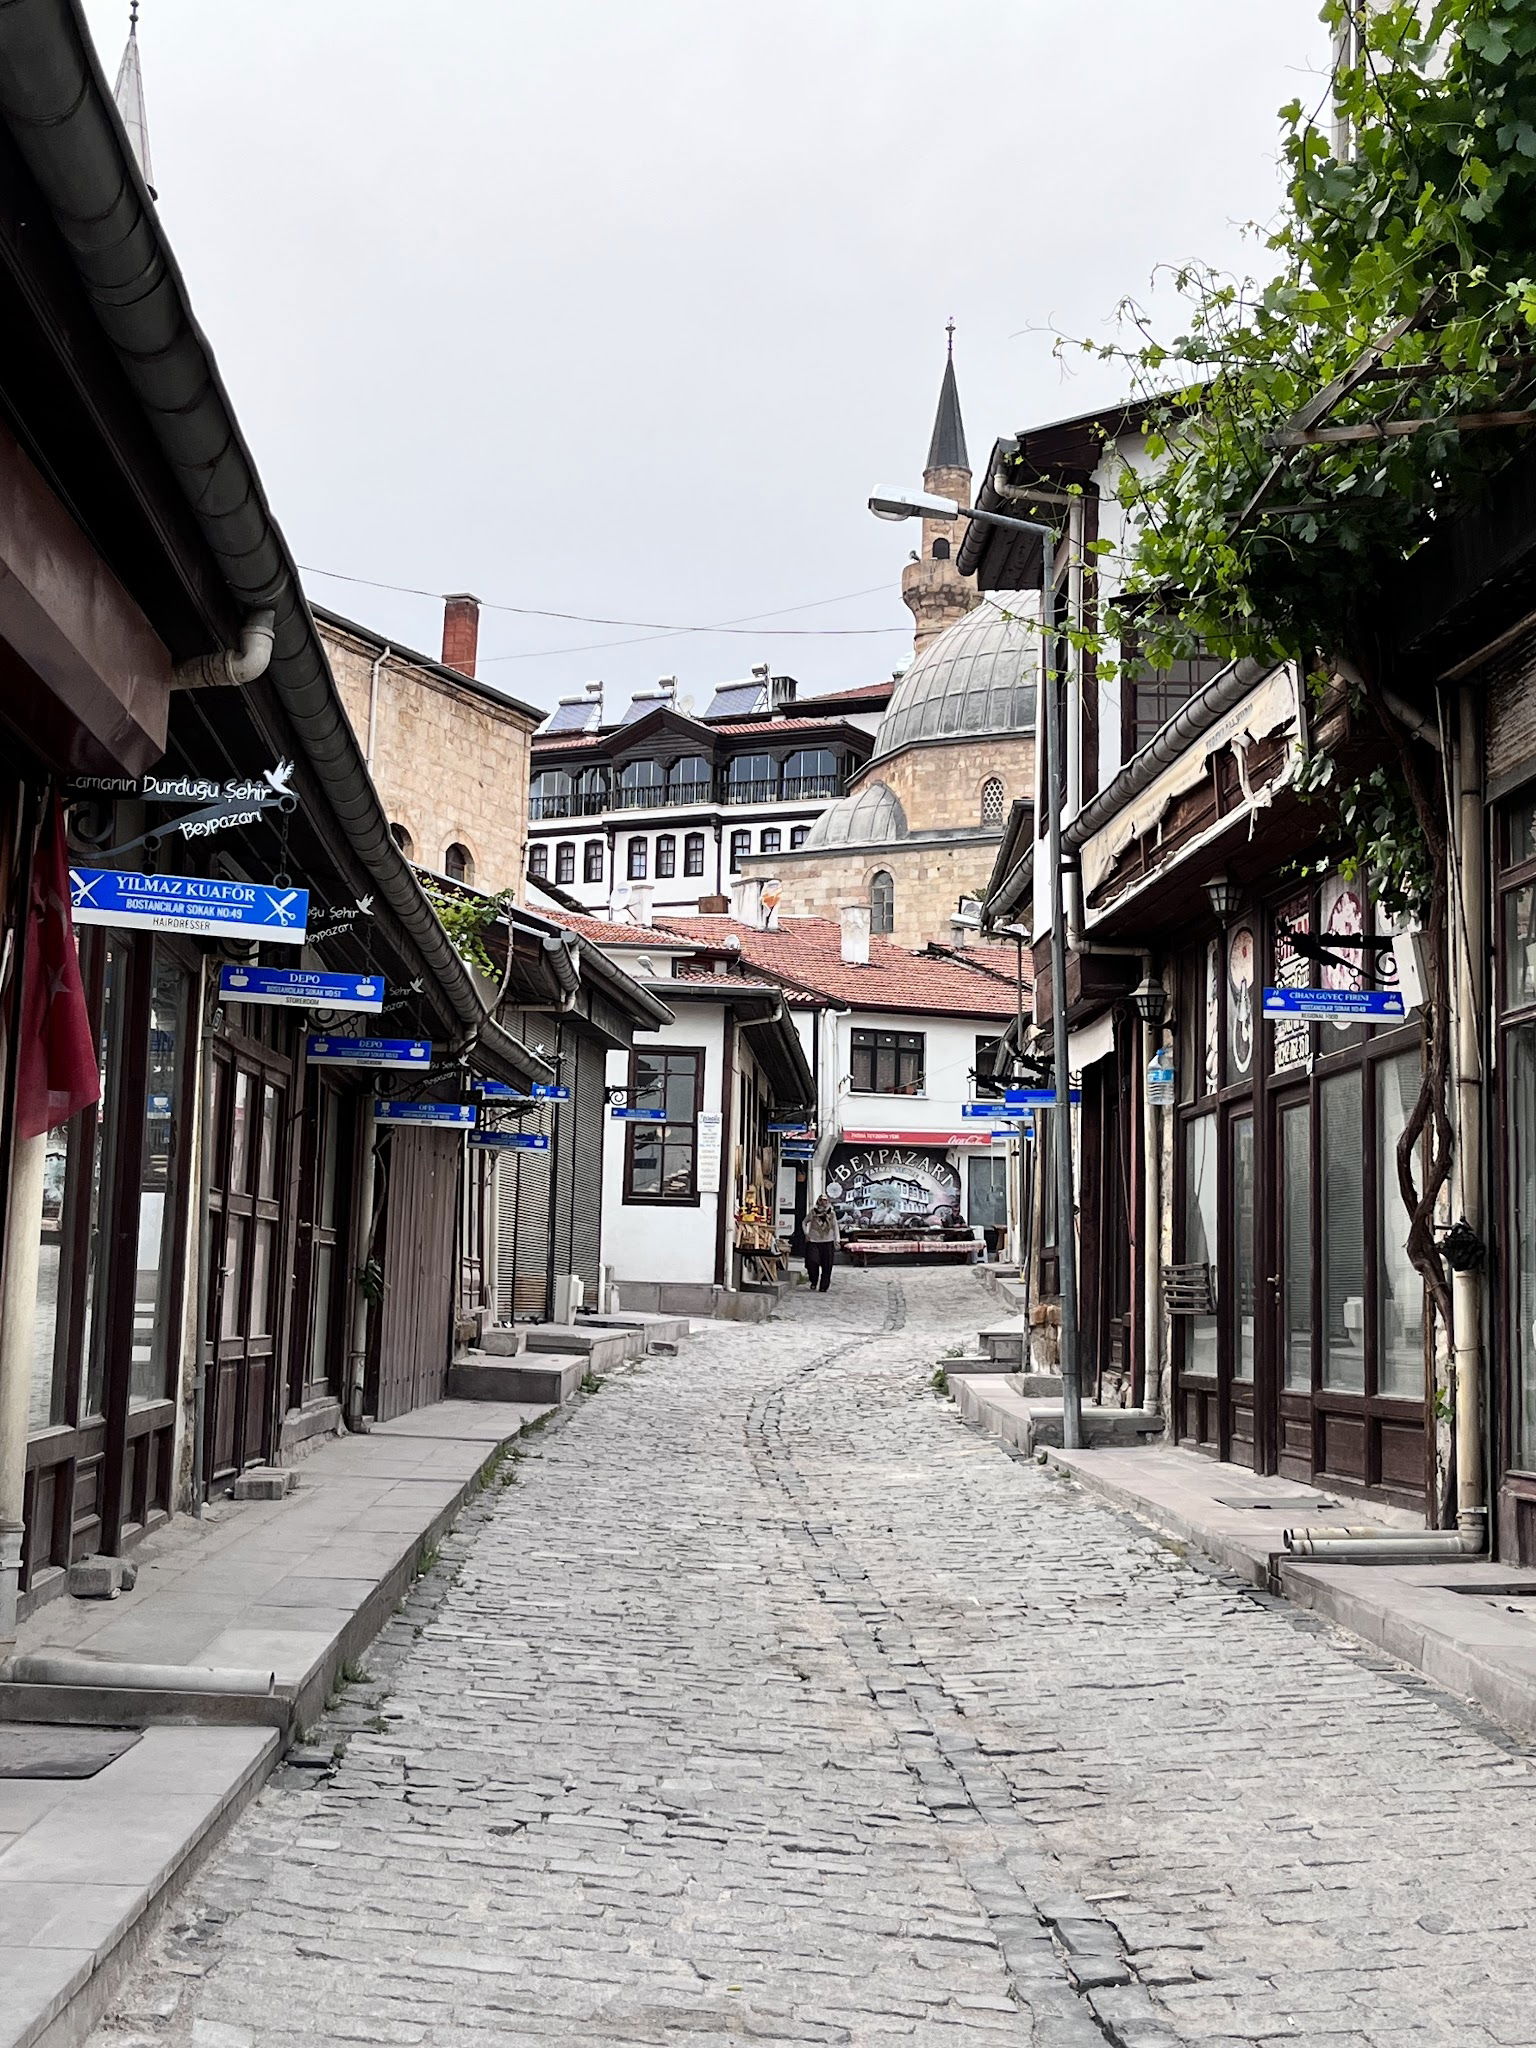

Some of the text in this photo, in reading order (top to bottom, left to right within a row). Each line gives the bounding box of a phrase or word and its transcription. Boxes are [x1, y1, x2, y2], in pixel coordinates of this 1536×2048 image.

[67, 774, 272, 803] amanın Durduğu Şehir
[178, 810, 262, 840] Beypazarı
[116, 876, 256, 902] YILMAZ KUAFÖR
[126, 898, 243, 919] BOSTANCILAR SOKAK NO:49
[152, 917, 211, 930] HAIRDRESSER
[289, 973, 321, 984] DEPO
[359, 1040, 383, 1049] DEPO
[835, 1149, 954, 1186] BEYPAZARI
